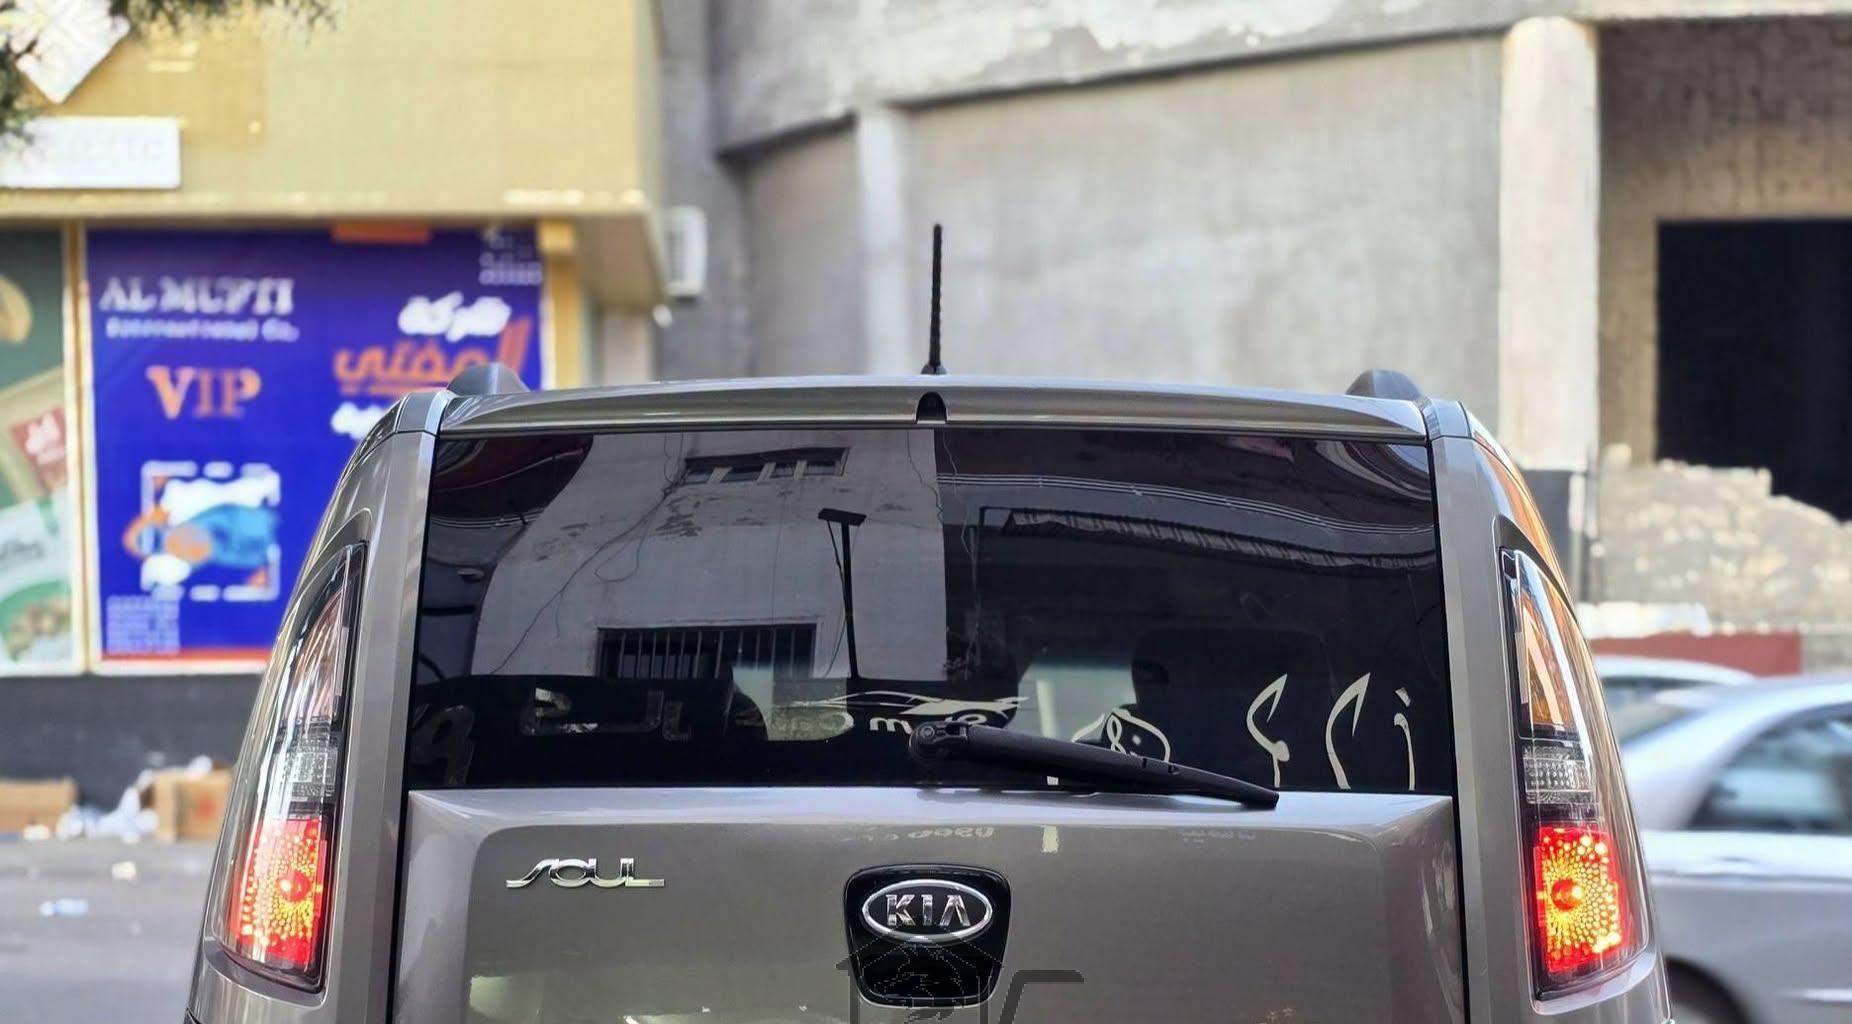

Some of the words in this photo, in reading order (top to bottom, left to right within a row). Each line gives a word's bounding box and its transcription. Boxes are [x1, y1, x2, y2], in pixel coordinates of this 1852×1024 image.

[99, 276, 157, 313] AL
[158, 275, 295, 316] MUFTI
[145, 365, 262, 420] VIP
[505, 857, 666, 889] SOUL
[885, 893, 972, 927] KIA
